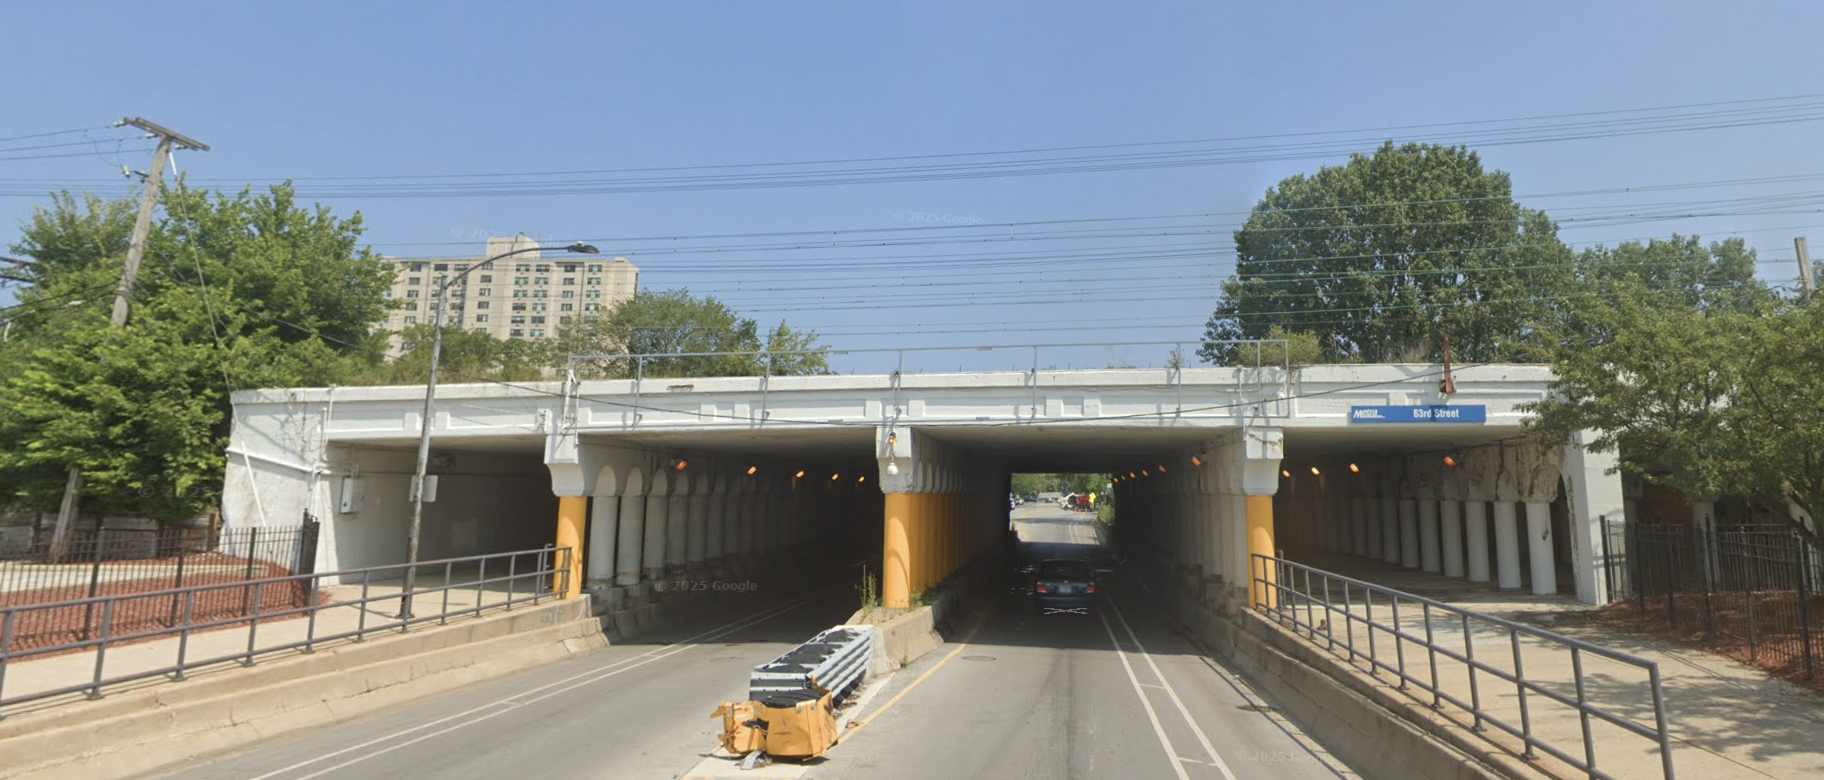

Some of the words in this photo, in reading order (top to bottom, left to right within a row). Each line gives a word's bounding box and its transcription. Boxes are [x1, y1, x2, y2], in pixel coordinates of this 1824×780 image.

[1353, 409, 1379, 418] Metra
[1413, 408, 1432, 418] 63rd
[1434, 408, 1459, 418] Street
